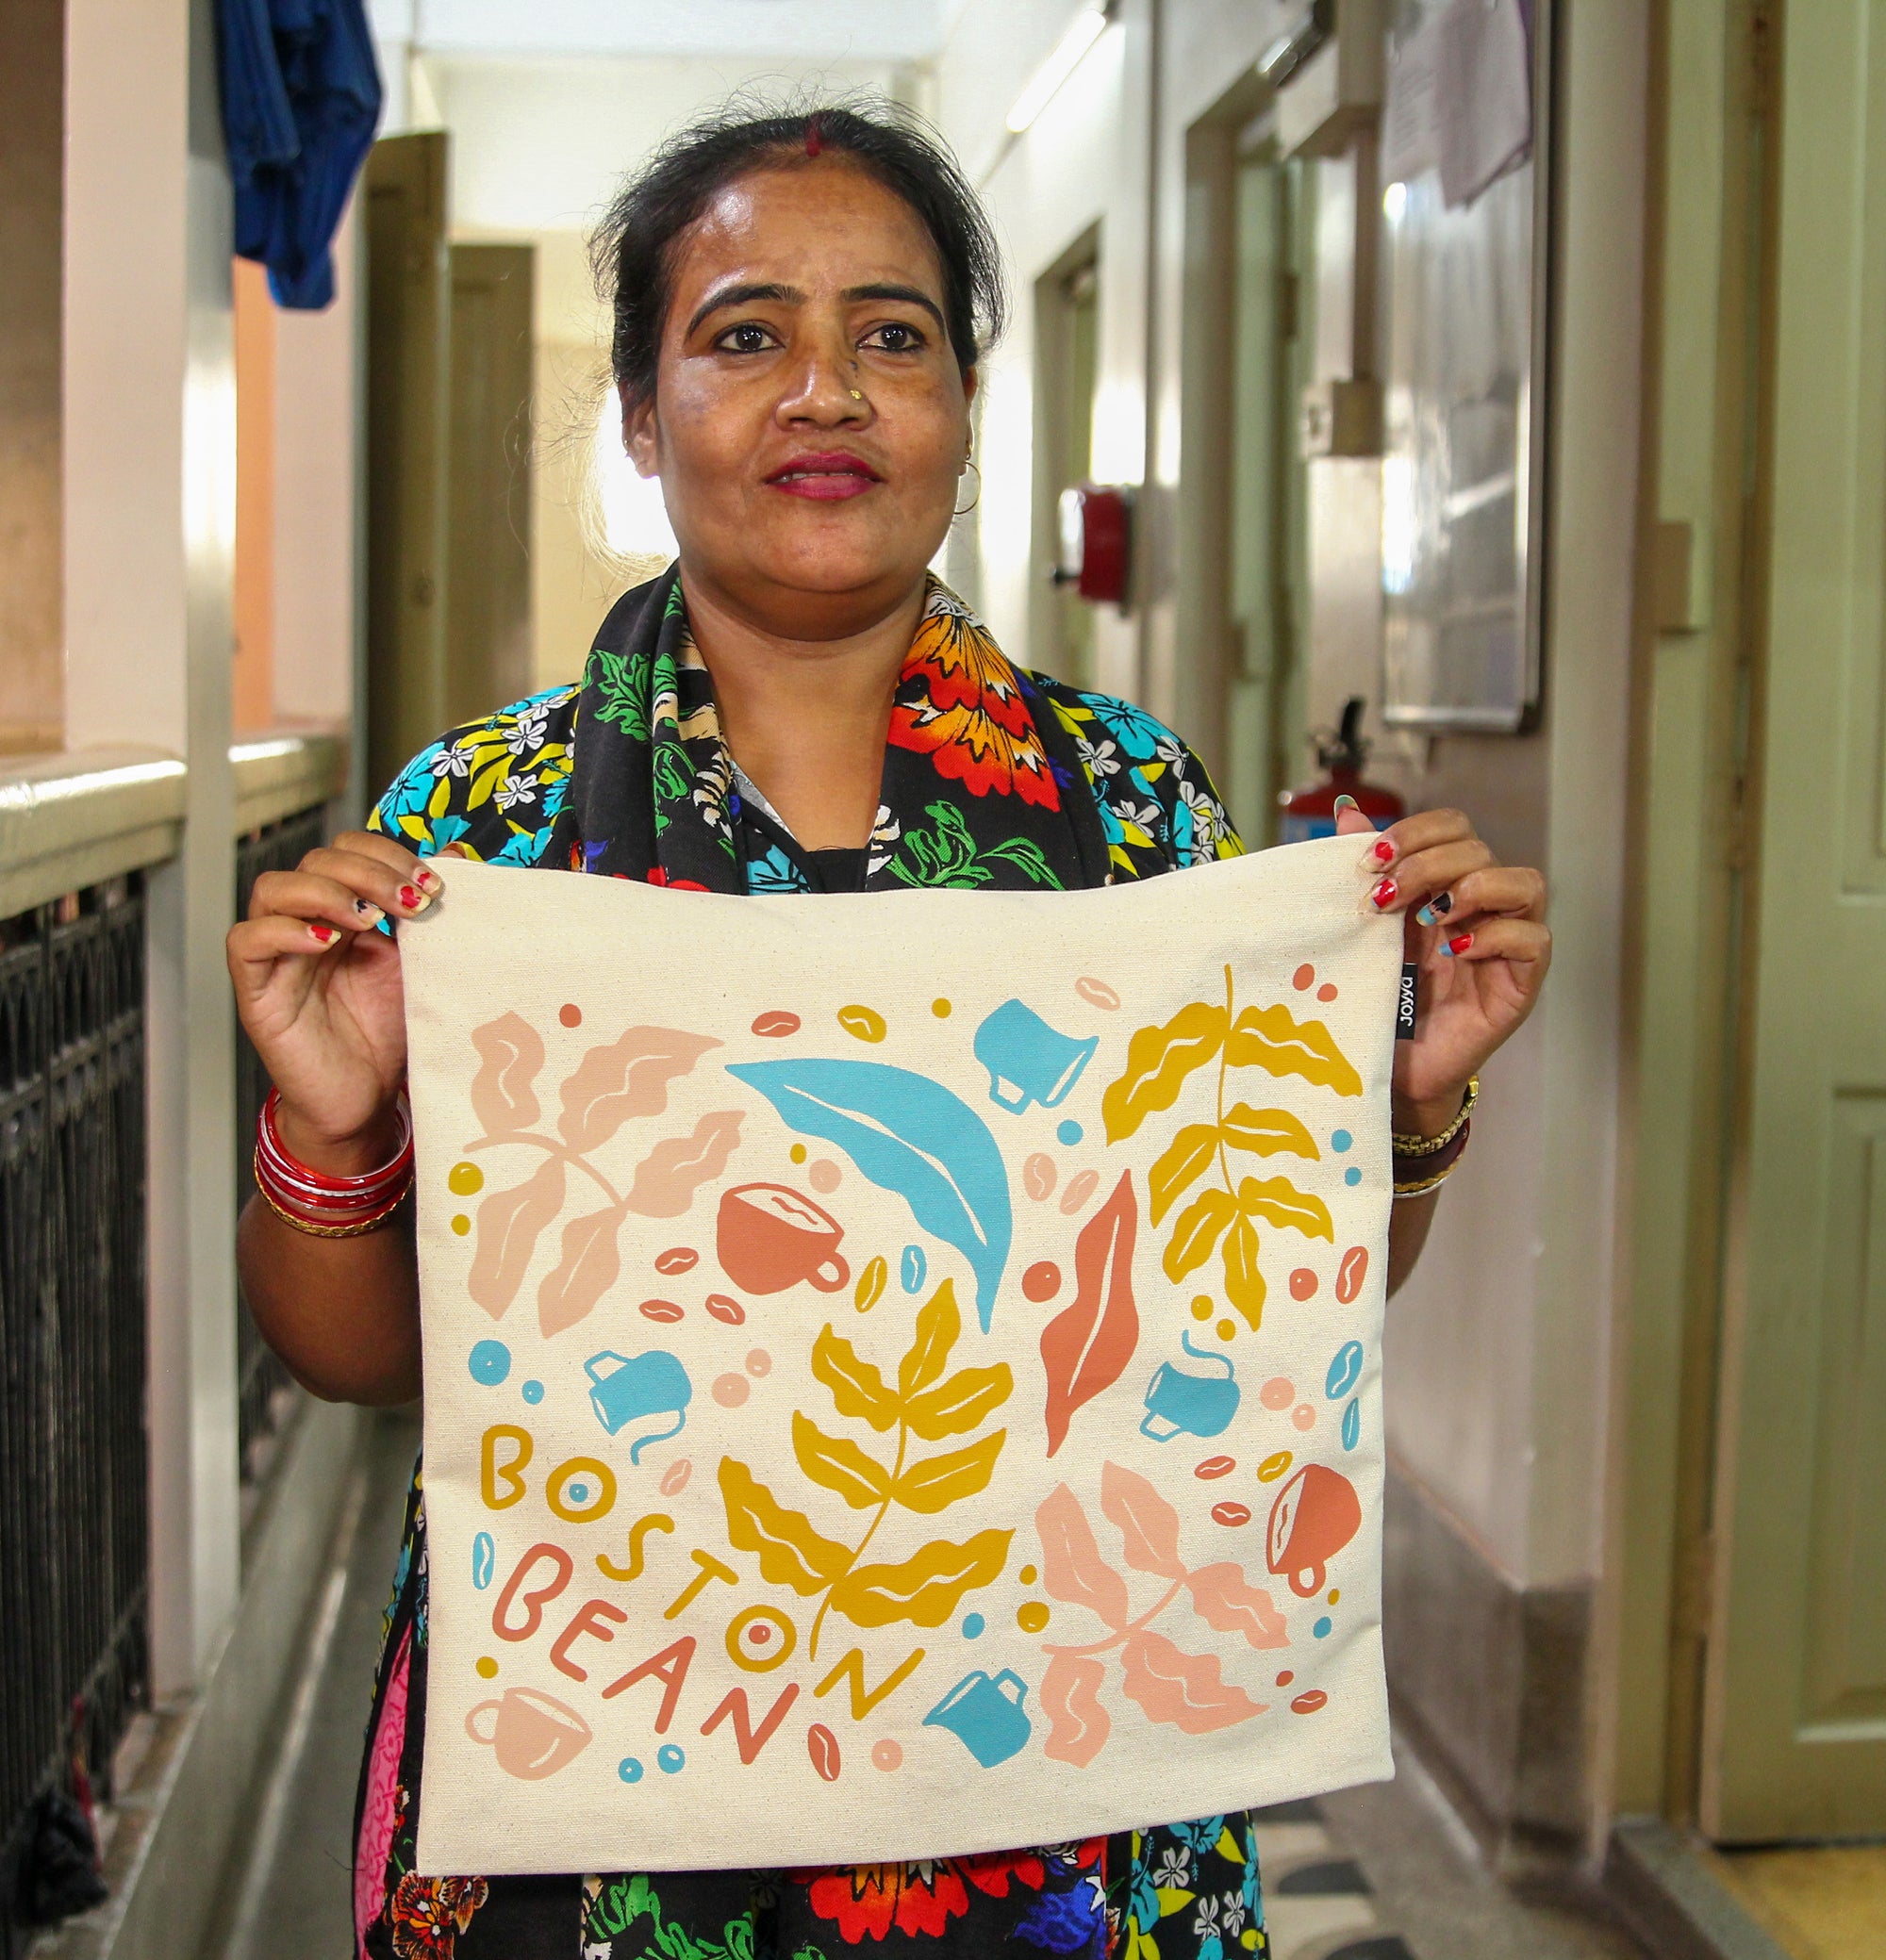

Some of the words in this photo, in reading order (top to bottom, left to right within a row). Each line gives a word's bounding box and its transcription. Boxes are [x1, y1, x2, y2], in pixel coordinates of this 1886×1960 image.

[1399, 976, 1414, 1027] Joyya
[481, 1424, 925, 1721] BOSTON
[492, 1542, 800, 1766] BEAN
